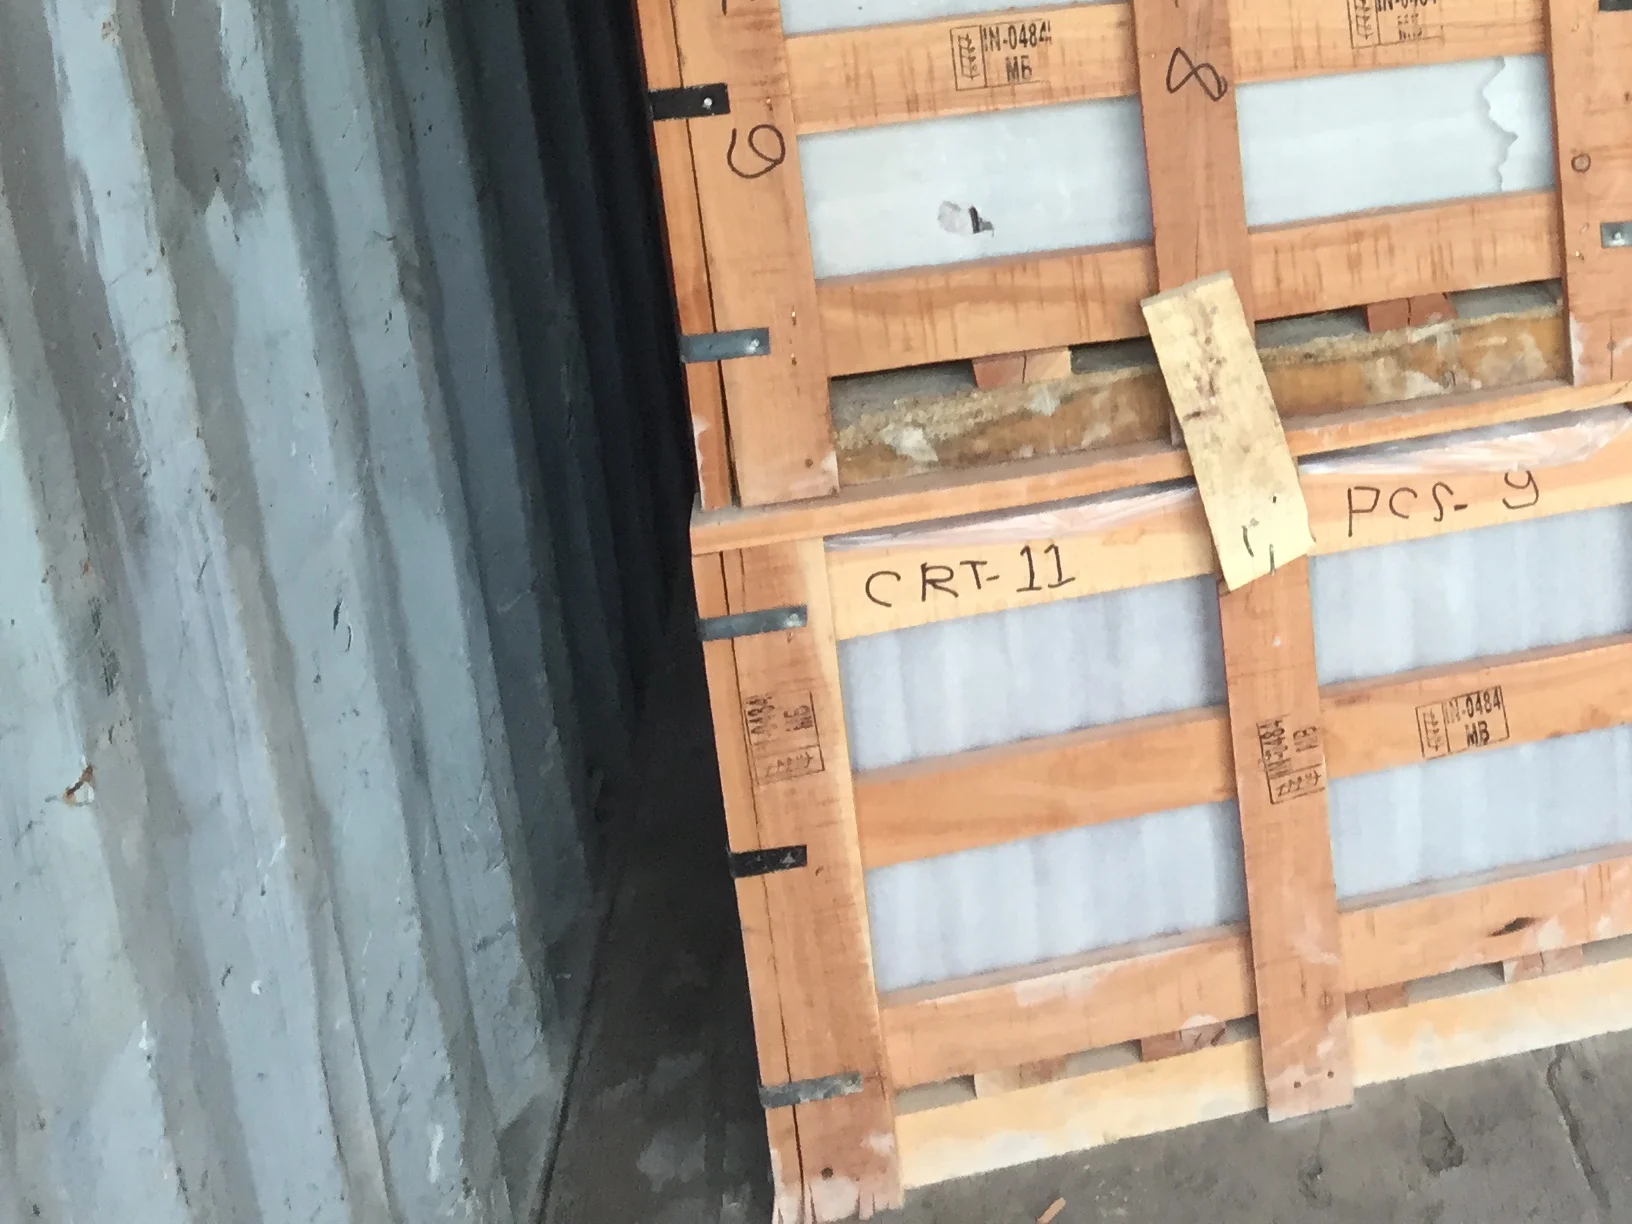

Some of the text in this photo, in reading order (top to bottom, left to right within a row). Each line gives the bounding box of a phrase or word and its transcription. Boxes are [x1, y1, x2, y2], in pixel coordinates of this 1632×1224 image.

[727, 124, 787, 180] 9
[865, 543, 1076, 608] CRT-11
[1465, 720, 1491, 748] MB
